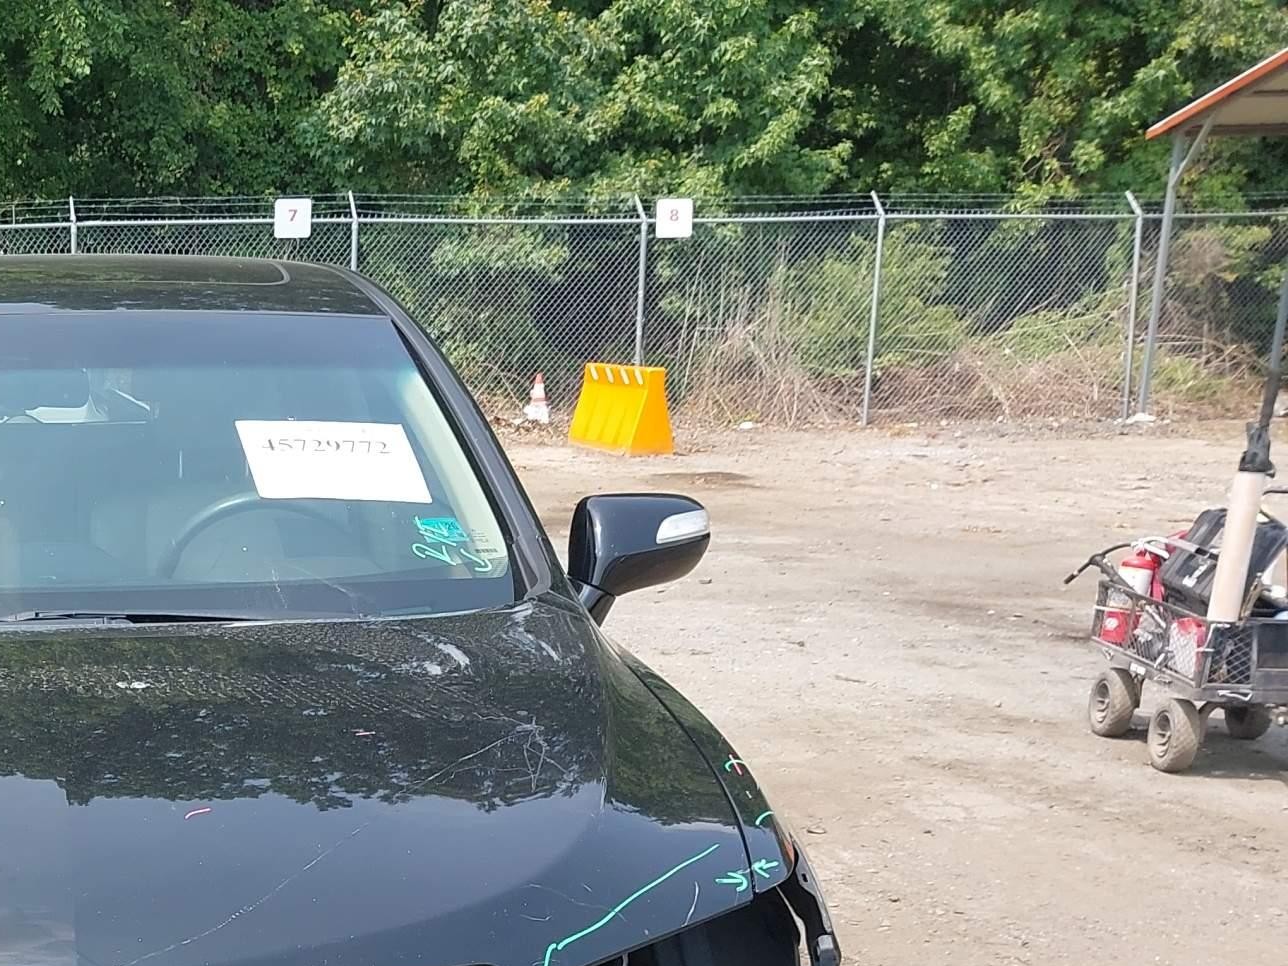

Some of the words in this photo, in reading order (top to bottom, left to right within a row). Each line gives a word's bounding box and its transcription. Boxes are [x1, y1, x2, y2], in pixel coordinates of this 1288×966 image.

[288, 209, 298, 222] 7
[669, 208, 679, 222] 8
[261, 438, 392, 455] 45729772
